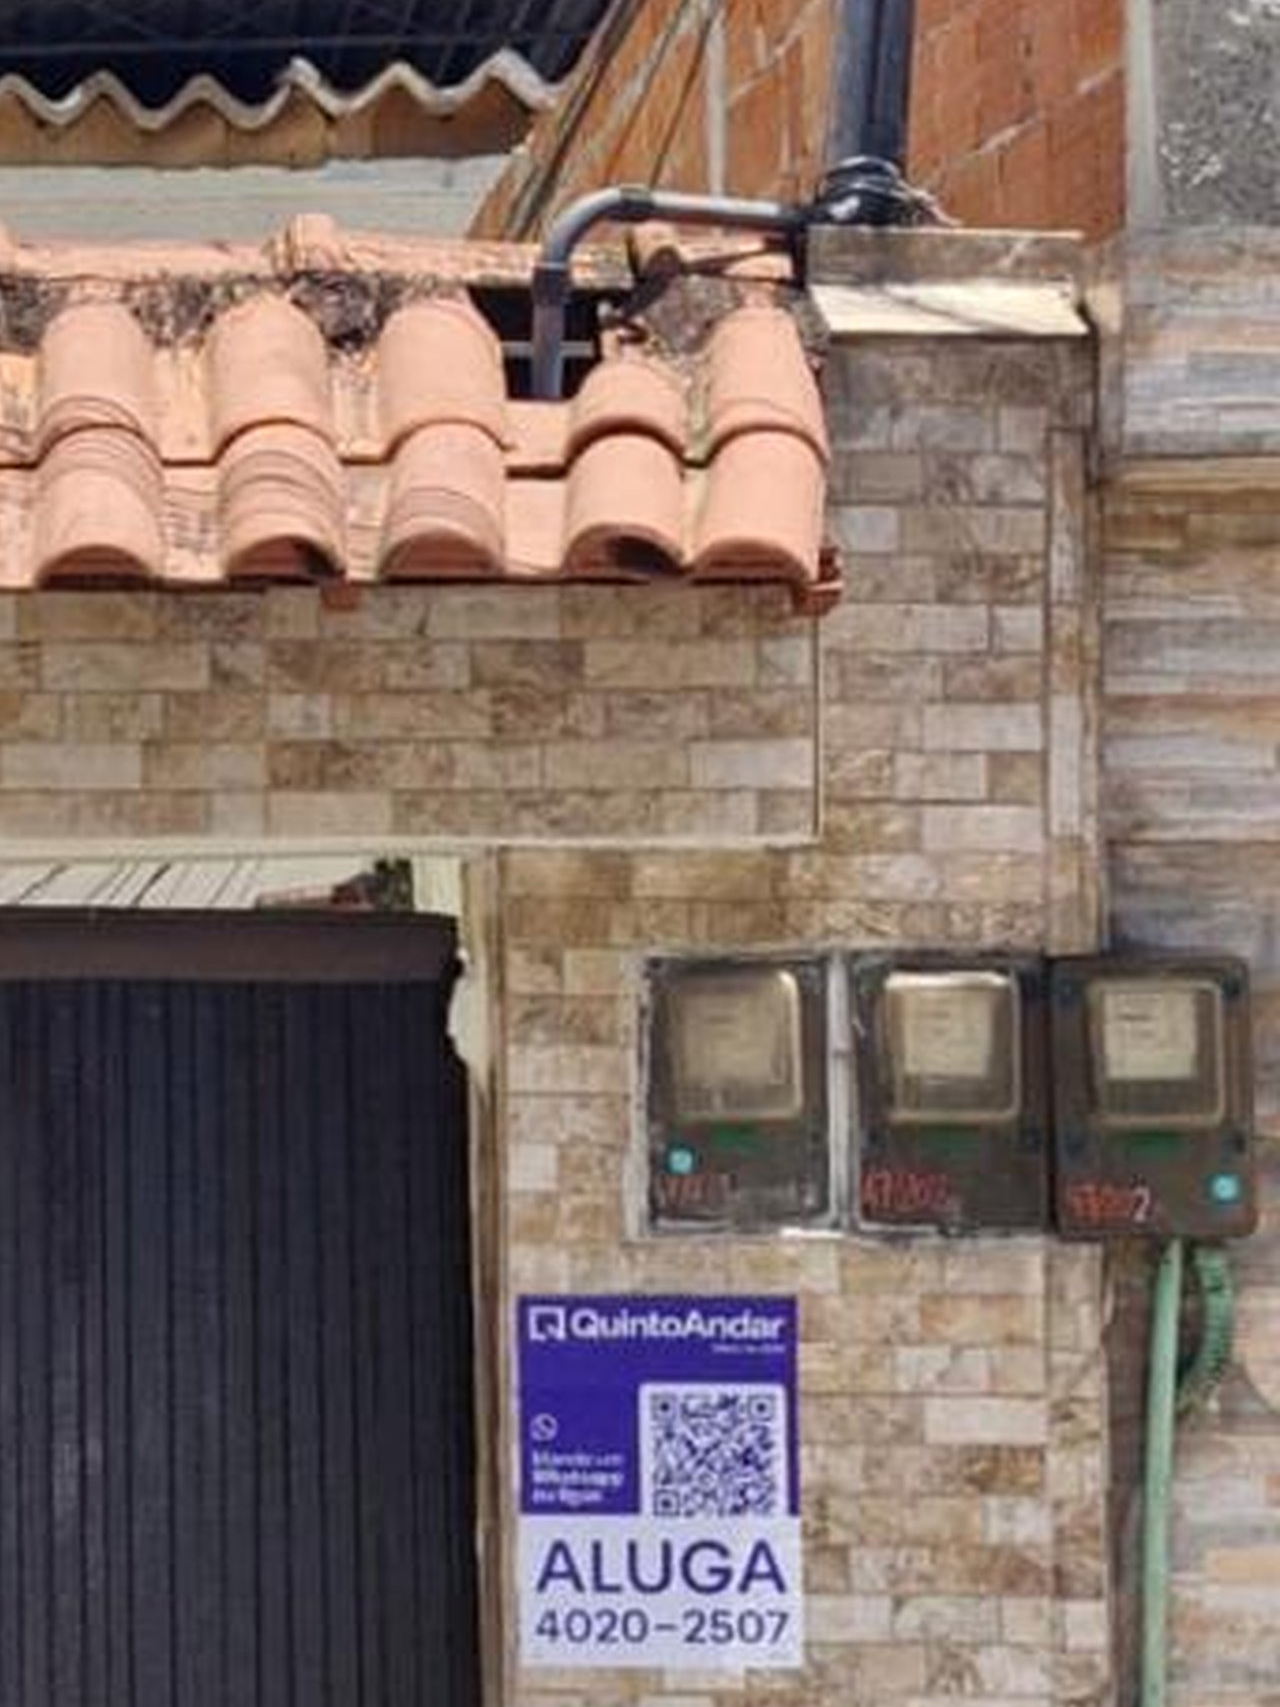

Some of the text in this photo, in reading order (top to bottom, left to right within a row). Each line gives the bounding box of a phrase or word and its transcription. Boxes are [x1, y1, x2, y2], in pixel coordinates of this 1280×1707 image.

[570, 1307, 785, 1340] QuintoAndar
[535, 1538, 787, 1595] ALUGA
[535, 1607, 789, 1646] 4020-2507
